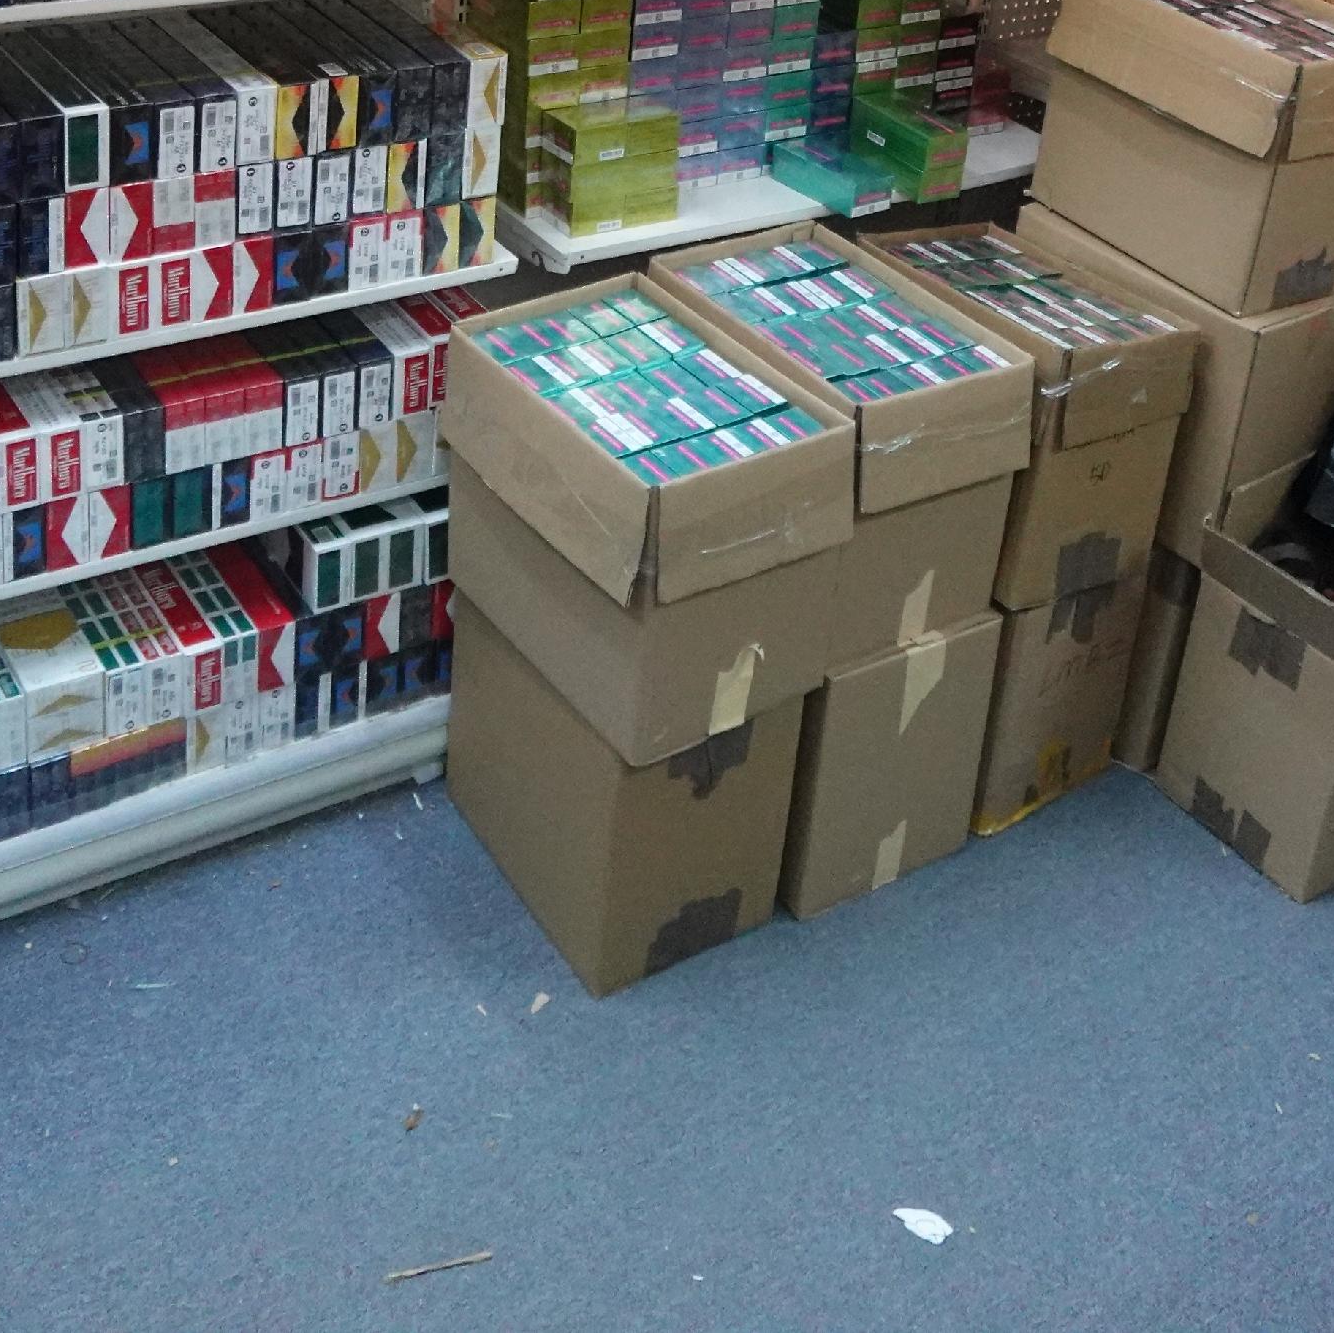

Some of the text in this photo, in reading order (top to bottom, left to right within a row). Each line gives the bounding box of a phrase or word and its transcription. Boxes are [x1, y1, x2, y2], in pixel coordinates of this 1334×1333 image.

[127, 274, 147, 326] Marlboro
[168, 267, 190, 318] Marlboro
[410, 362, 428, 407] Marlboro
[13, 447, 36, 498] Marlboro
[58, 438, 80, 489] Marlboro
[200, 656, 220, 703] Marlboro
